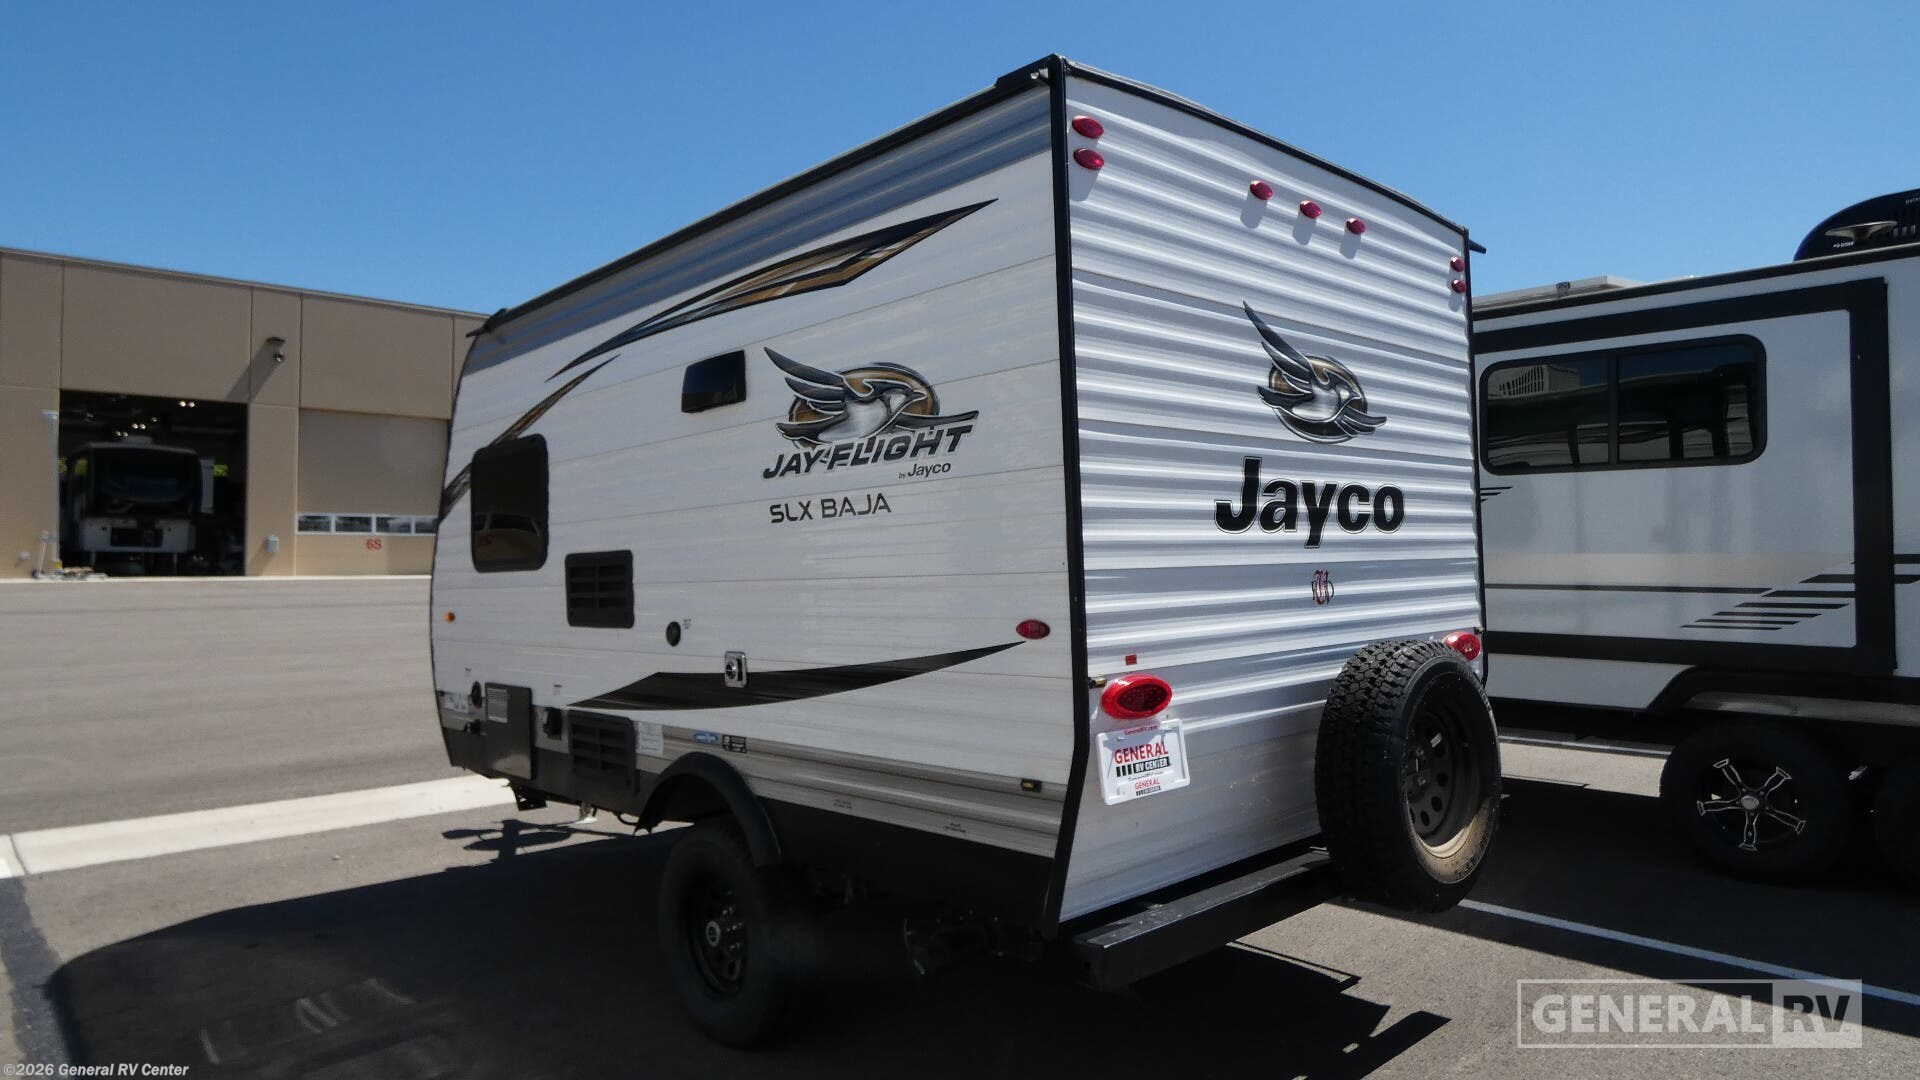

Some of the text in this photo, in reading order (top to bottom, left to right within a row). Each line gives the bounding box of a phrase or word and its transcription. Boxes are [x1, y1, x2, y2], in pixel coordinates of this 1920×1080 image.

[762, 424, 973, 479] JAY FLIGHT
[898, 461, 951, 480] by Jayco
[769, 492, 892, 524] SLX BAJA
[1213, 455, 1406, 550] Jayco
[1115, 741, 1168, 764] GENERAL
[1135, 758, 1167, 773] RV CENTER
[1135, 778, 1160, 789] GENERAL
